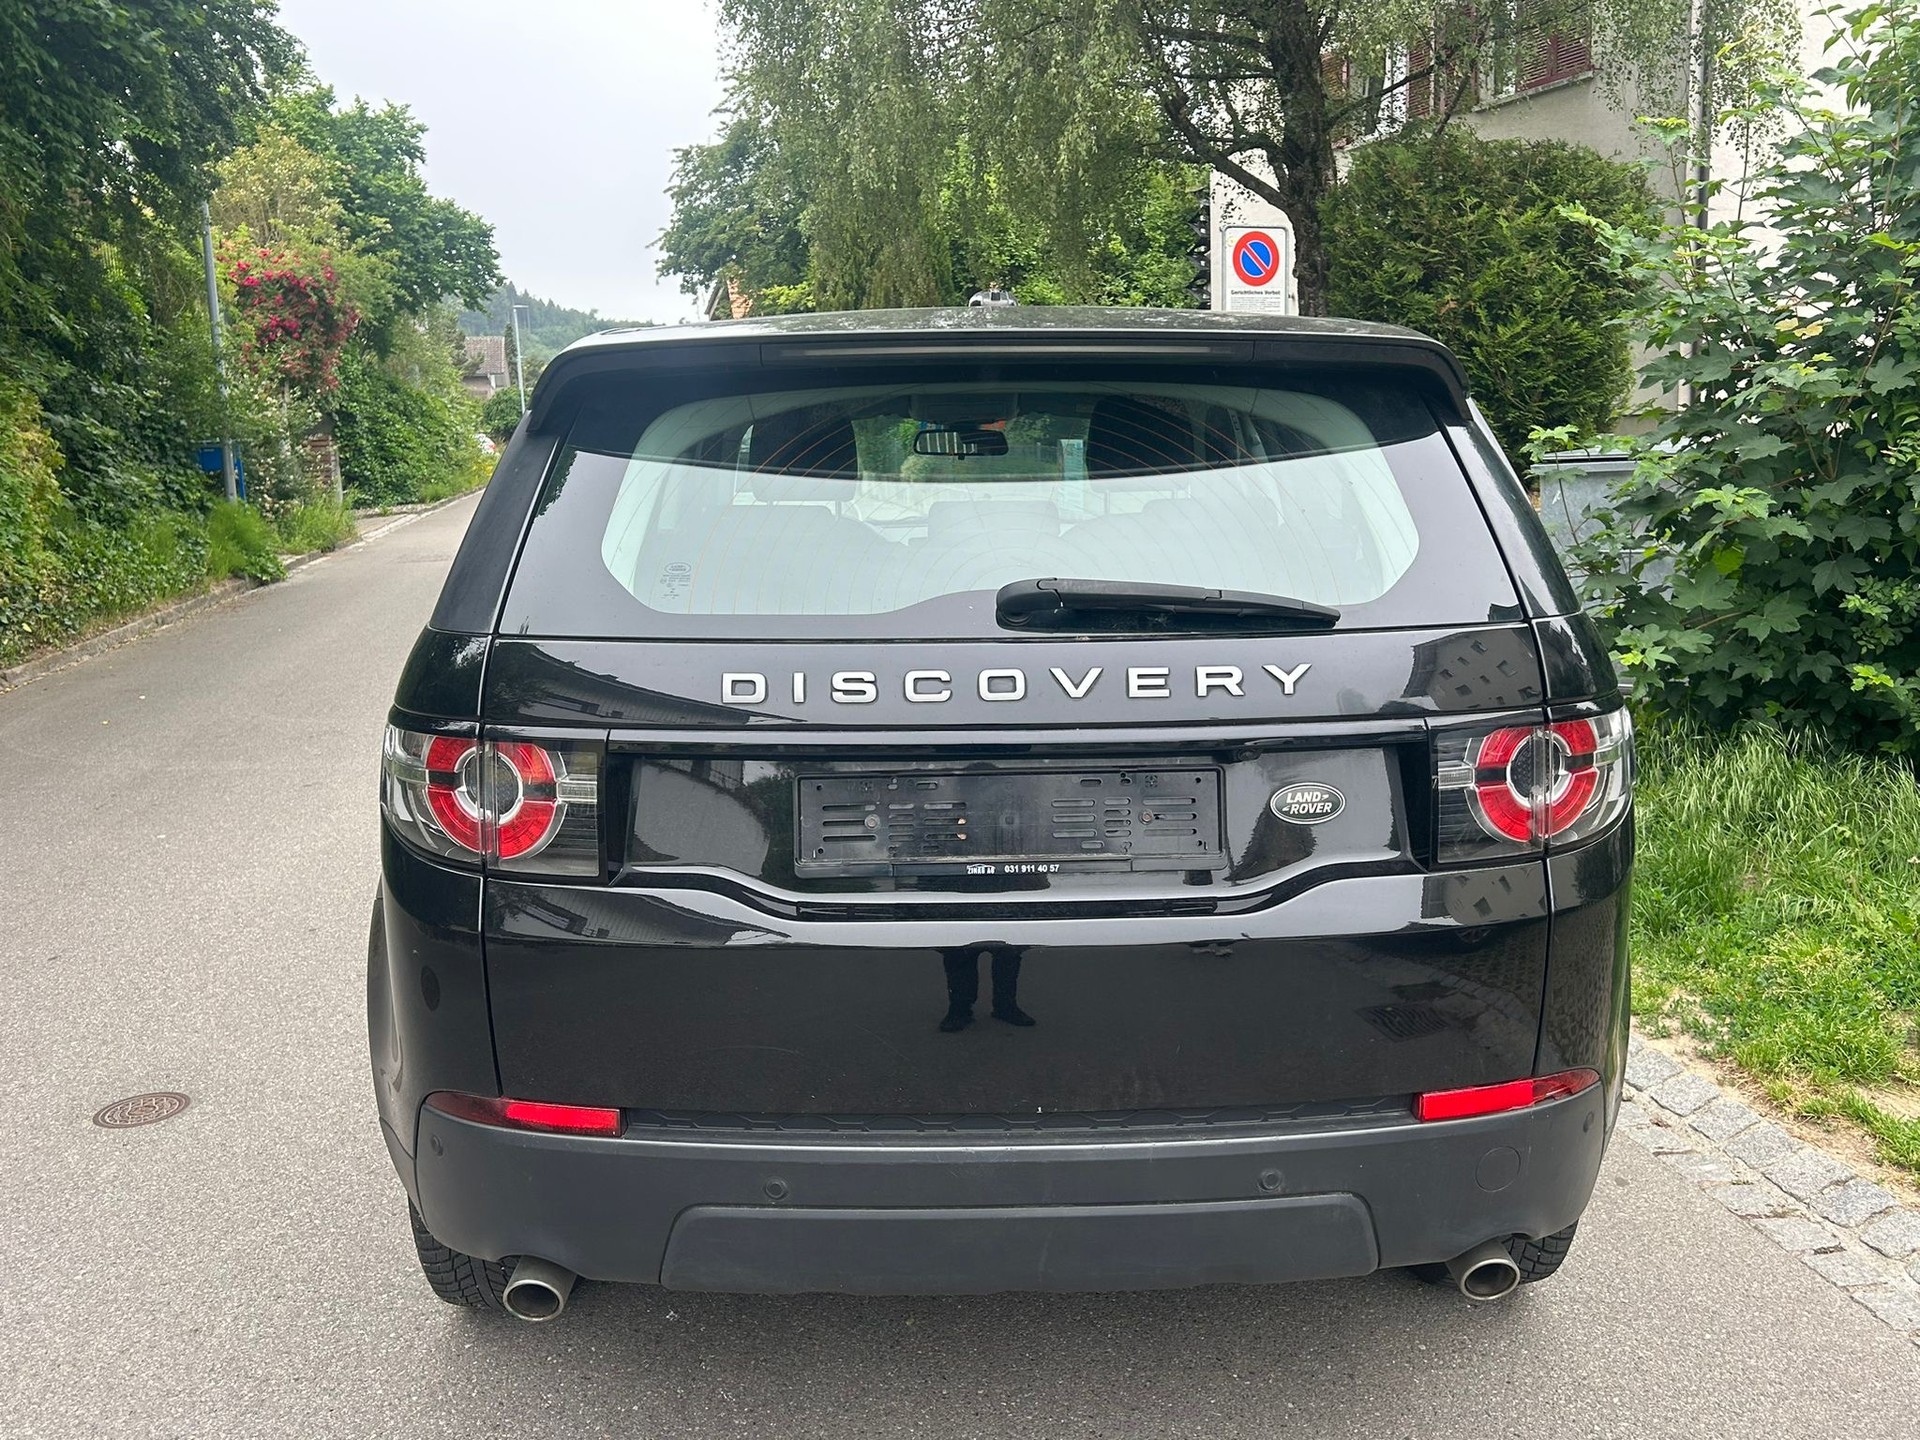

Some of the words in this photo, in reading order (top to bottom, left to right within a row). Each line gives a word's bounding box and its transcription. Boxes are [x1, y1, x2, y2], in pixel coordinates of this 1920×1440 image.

[721, 663, 1312, 704] DISCOVERY
[1286, 791, 1321, 803] LAND
[1289, 802, 1333, 815] ROVER
[1004, 865, 1019, 873] 031
[1021, 864, 1035, 873] 911
[1037, 864, 1048, 872] 40
[1049, 864, 1060, 872] 57
